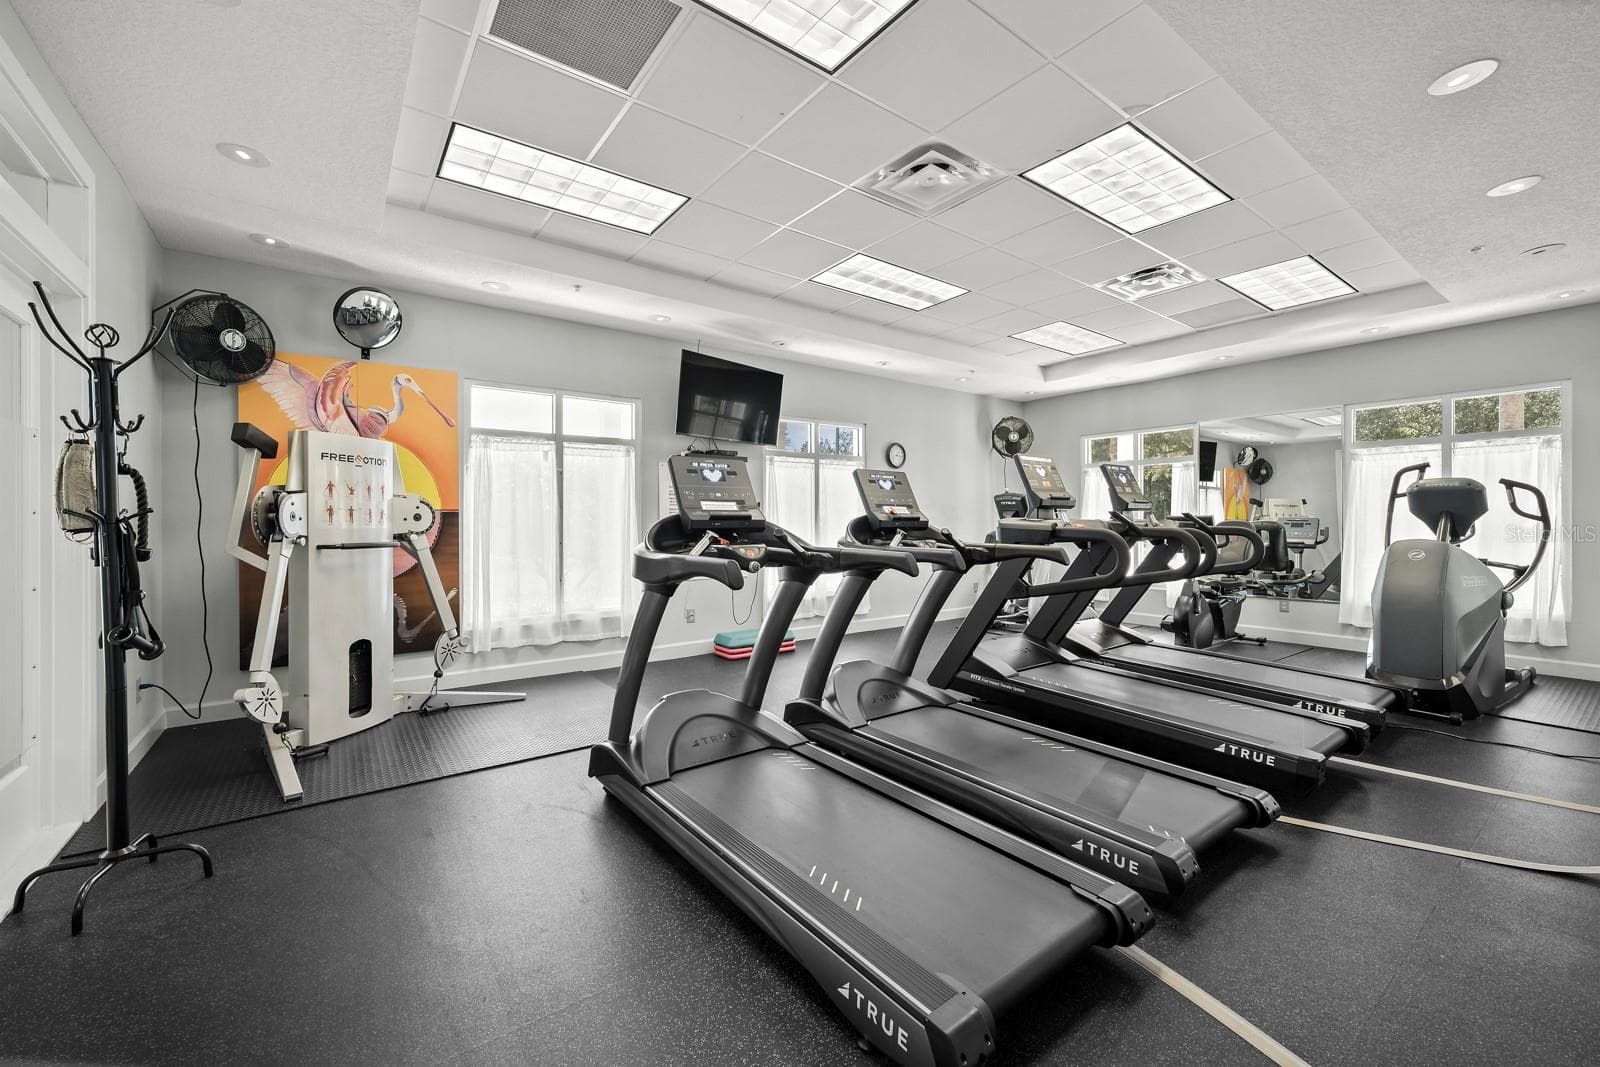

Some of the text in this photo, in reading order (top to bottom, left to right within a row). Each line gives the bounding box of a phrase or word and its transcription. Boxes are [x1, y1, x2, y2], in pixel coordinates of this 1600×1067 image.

[1305, 702, 1346, 718] TRUE
[1228, 744, 1276, 767] TRUE
[1086, 841, 1139, 876] TRUE
[853, 987, 909, 1052] TRUE
